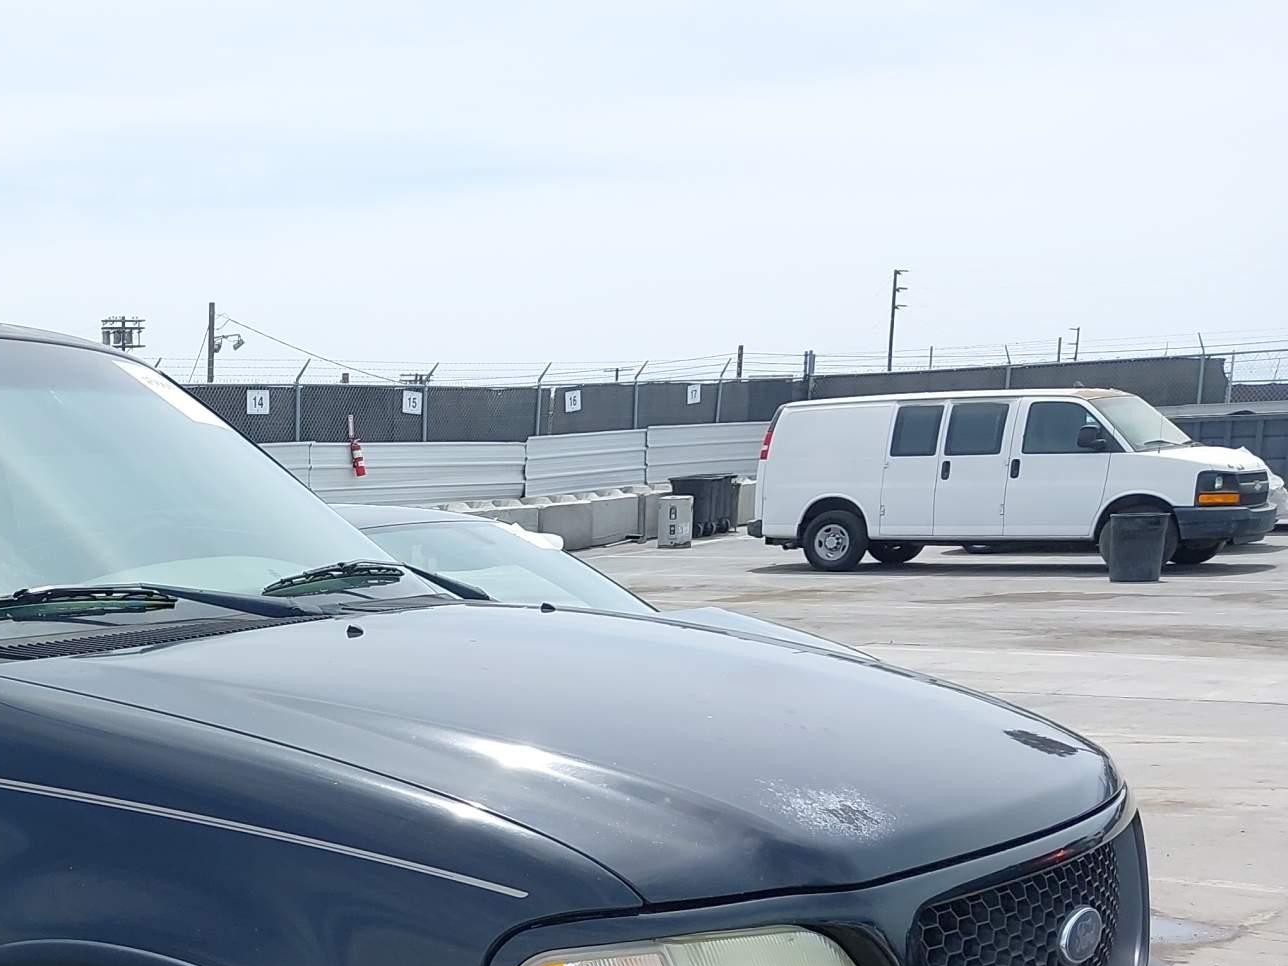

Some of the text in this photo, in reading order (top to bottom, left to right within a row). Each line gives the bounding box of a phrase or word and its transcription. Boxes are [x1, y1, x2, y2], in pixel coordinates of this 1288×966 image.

[253, 396, 264, 409] 14
[408, 397, 417, 409] 15
[569, 395, 577, 407] 16
